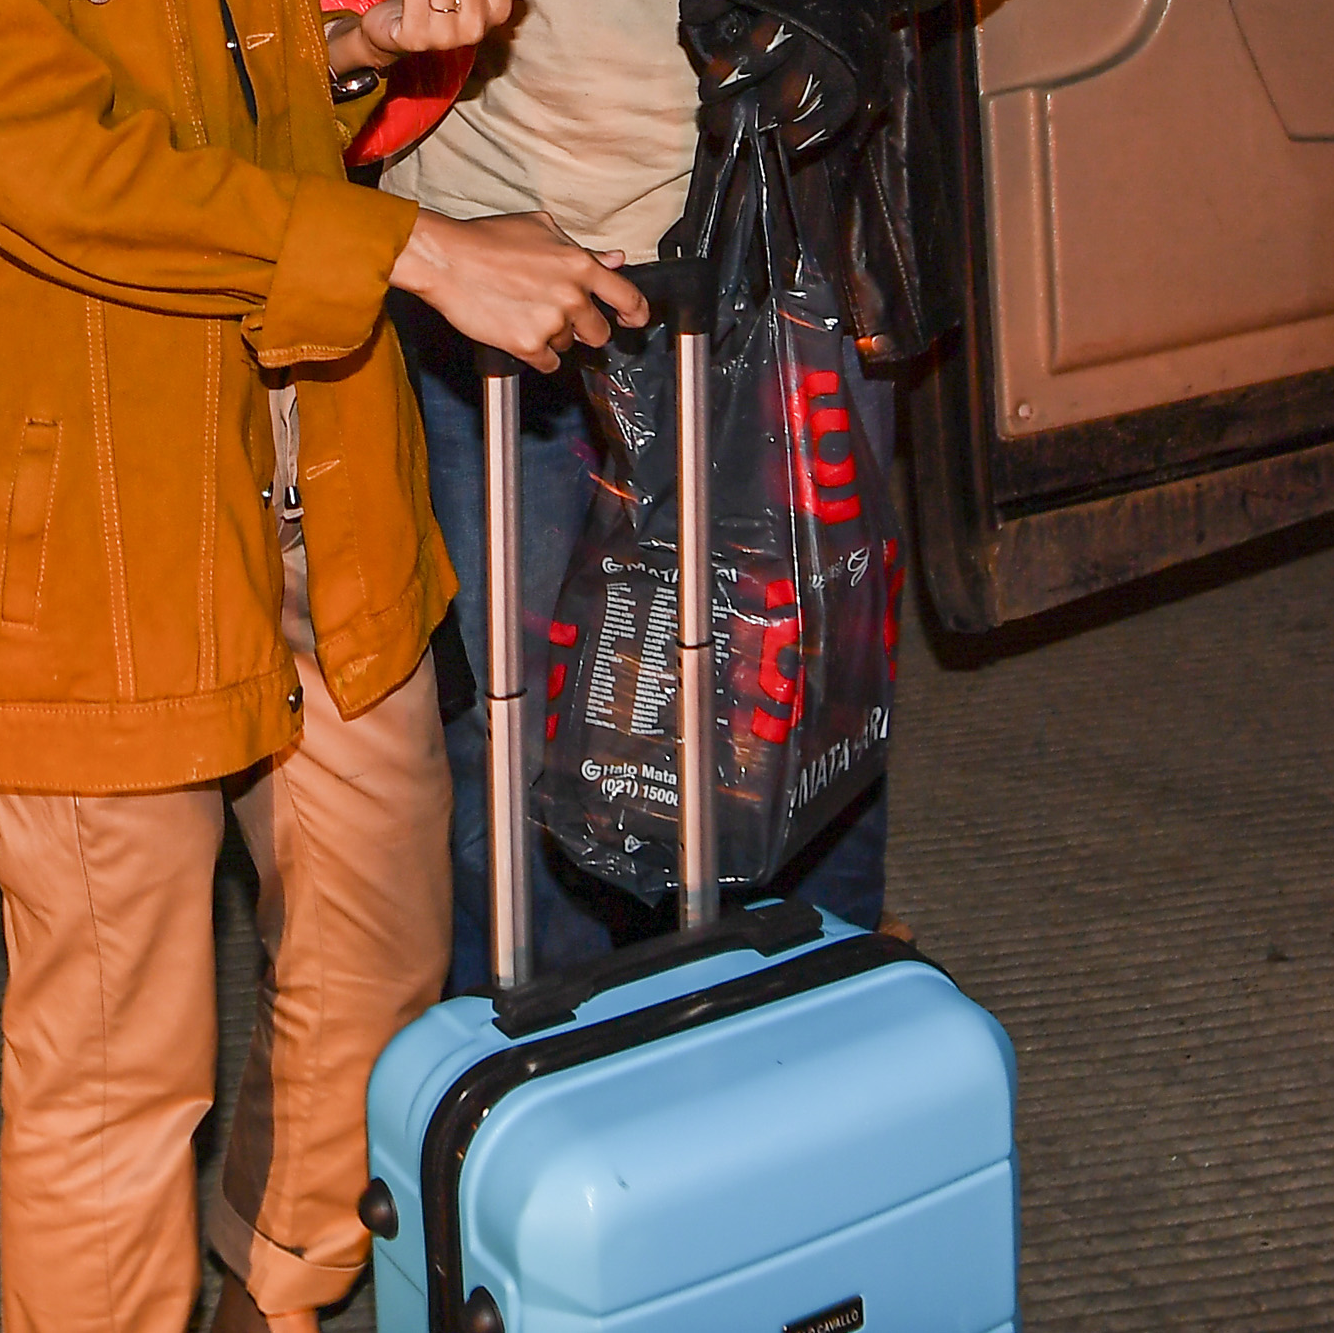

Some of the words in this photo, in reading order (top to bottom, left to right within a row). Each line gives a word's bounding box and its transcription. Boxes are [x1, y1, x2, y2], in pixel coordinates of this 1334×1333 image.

[603, 762, 638, 776] Halo
[642, 764, 678, 786] Mata
[601, 778, 639, 799] (021)
